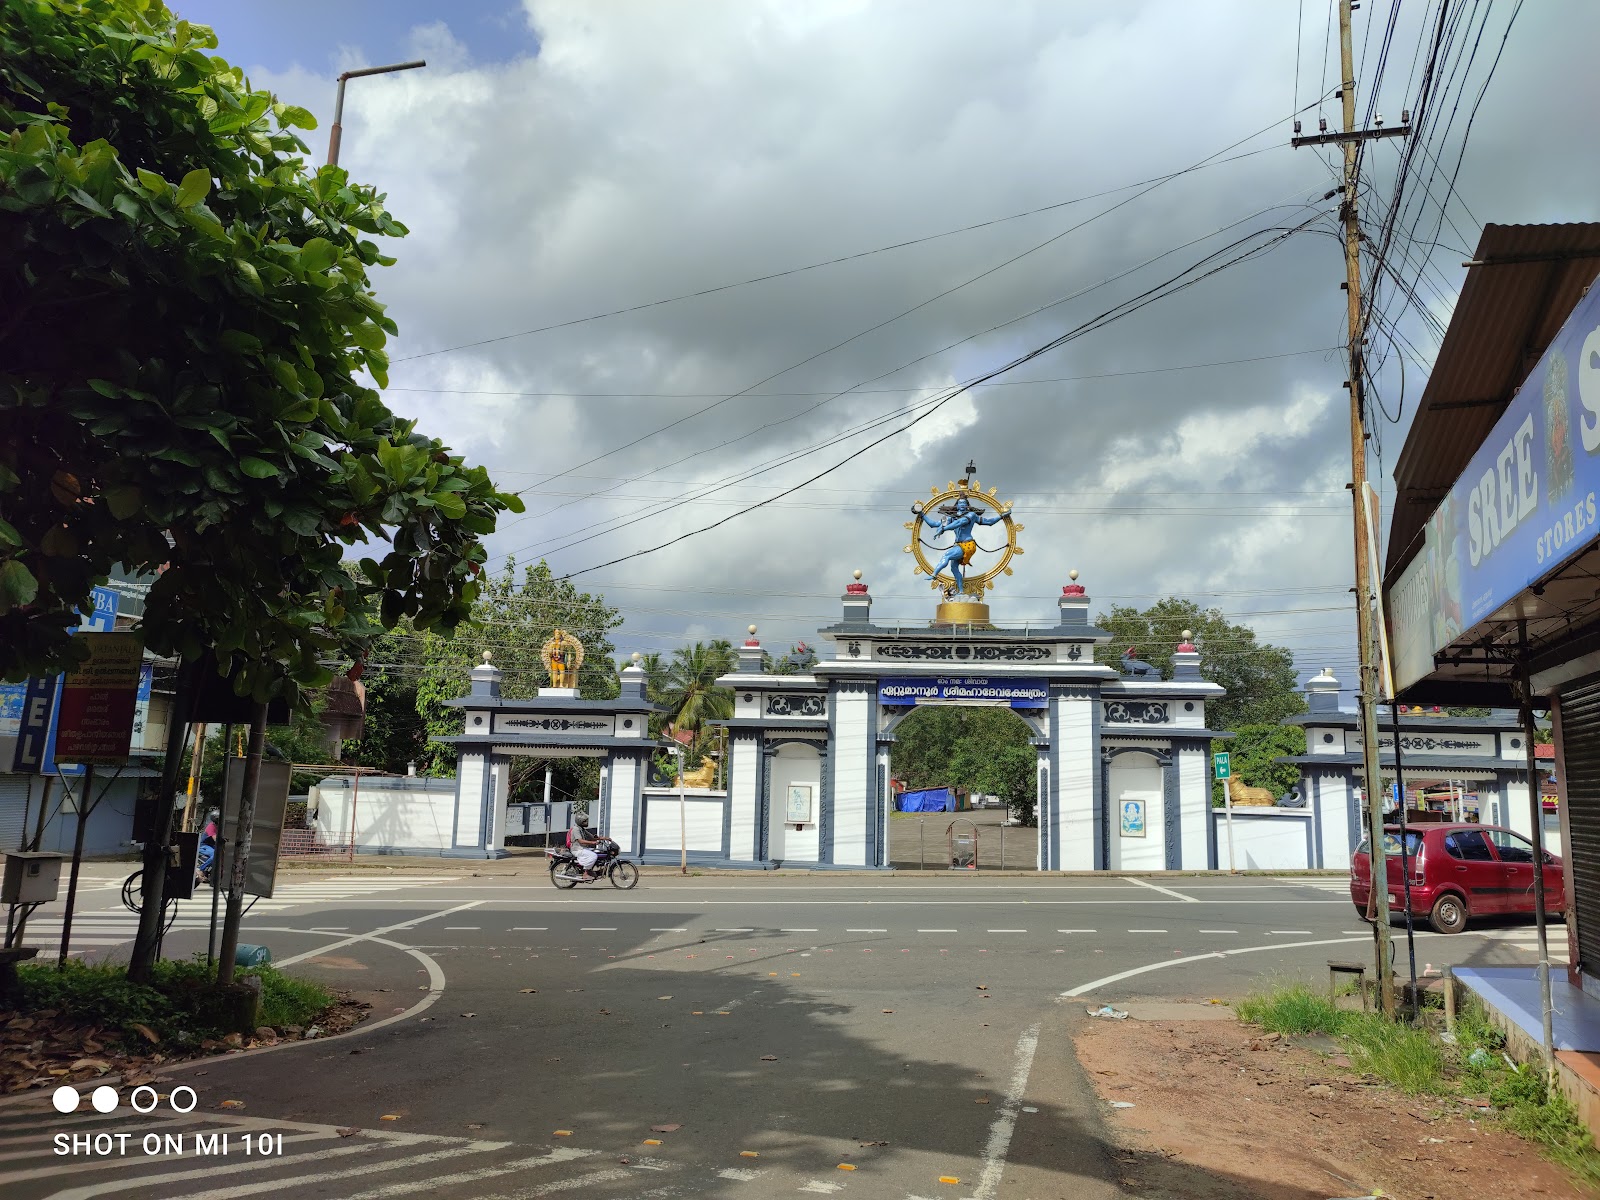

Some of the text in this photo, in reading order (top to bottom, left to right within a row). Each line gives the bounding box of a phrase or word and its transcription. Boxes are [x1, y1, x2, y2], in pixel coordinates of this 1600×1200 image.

[1468, 412, 1538, 567] SREE
[1536, 491, 1596, 565] STORES
[880, 685, 1047, 699] ഏറ്റുമാനൂർ ശ്രീമഹാദേവക്ഷേത്രം
[1217, 756, 1227, 764] PALA
